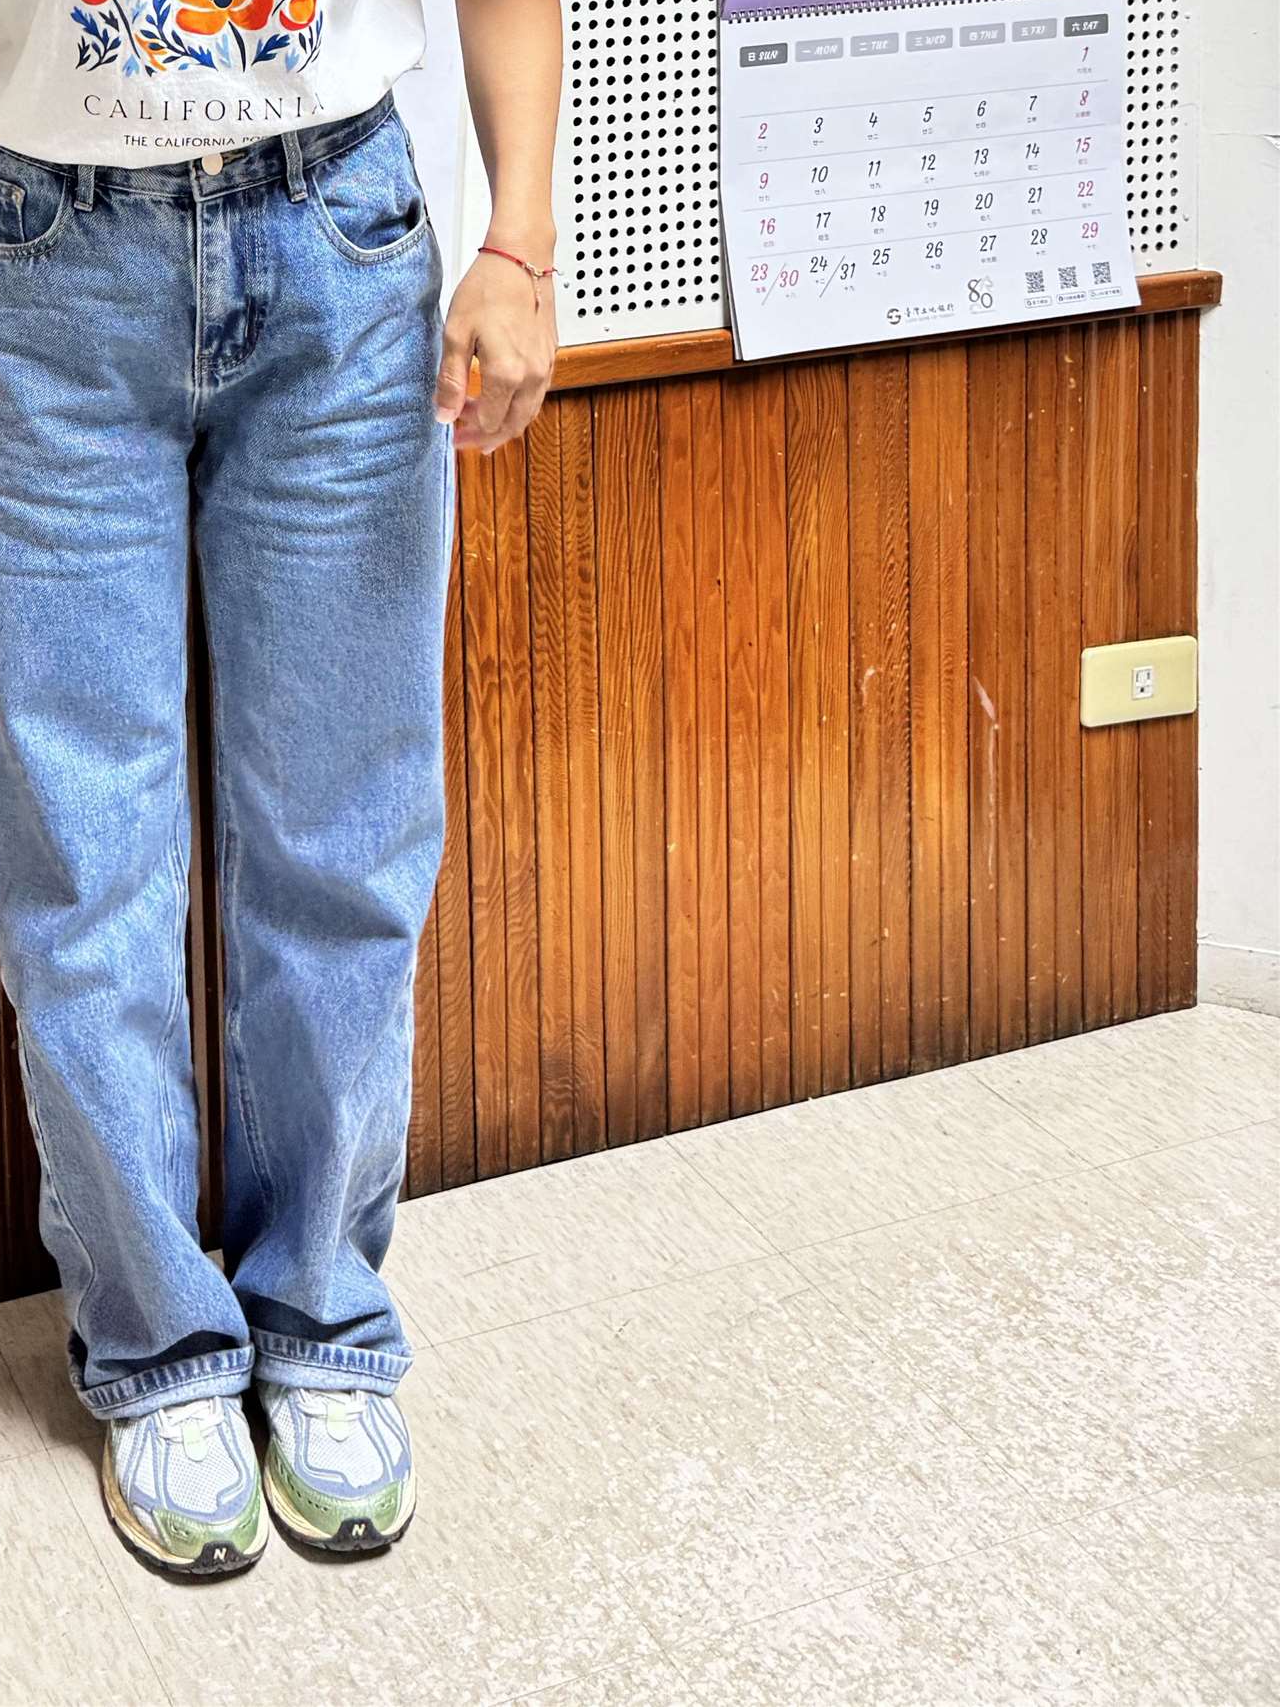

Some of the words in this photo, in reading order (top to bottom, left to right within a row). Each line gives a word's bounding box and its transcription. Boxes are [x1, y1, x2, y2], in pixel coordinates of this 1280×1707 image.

[1082, 21, 1099, 30] SAT
[758, 51, 778, 61] SUN
[1082, 47, 1088, 62] 1
[82, 92, 325, 121] CALIFORNIA
[758, 123, 767, 139] 2
[814, 117, 823, 133] 3
[869, 112, 877, 127] 4
[923, 107, 934, 122] 5
[977, 101, 986, 116] 6
[1030, 95, 1037, 111] 7
[1080, 90, 1089, 106] 8
[124, 135, 147, 146] THE
[154, 136, 236, 148] CALIFORNIA
[760, 173, 768, 189] 9
[812, 166, 828, 182] 10
[869, 161, 880, 176] 11
[922, 154, 935, 170] 12
[975, 148, 988, 164] 13
[1026, 143, 1039, 158] 14
[1076, 137, 1091, 152] 15
[760, 218, 775, 234] 16
[817, 212, 831, 228] 17
[871, 206, 886, 222] 18
[925, 199, 939, 215] 19
[975, 193, 993, 210] 20
[1028, 187, 1042, 203] 21
[1078, 181, 1093, 197] 22
[751, 263, 768, 281] 23
[780, 270, 799, 287] 30
[810, 256, 827, 273] 24
[840, 263, 855, 280] 31
[872, 248, 891, 265] 25
[926, 241, 943, 258] 26
[980, 235, 996, 251] 27
[1031, 228, 1047, 245] 28
[1082, 222, 1098, 238] 29
